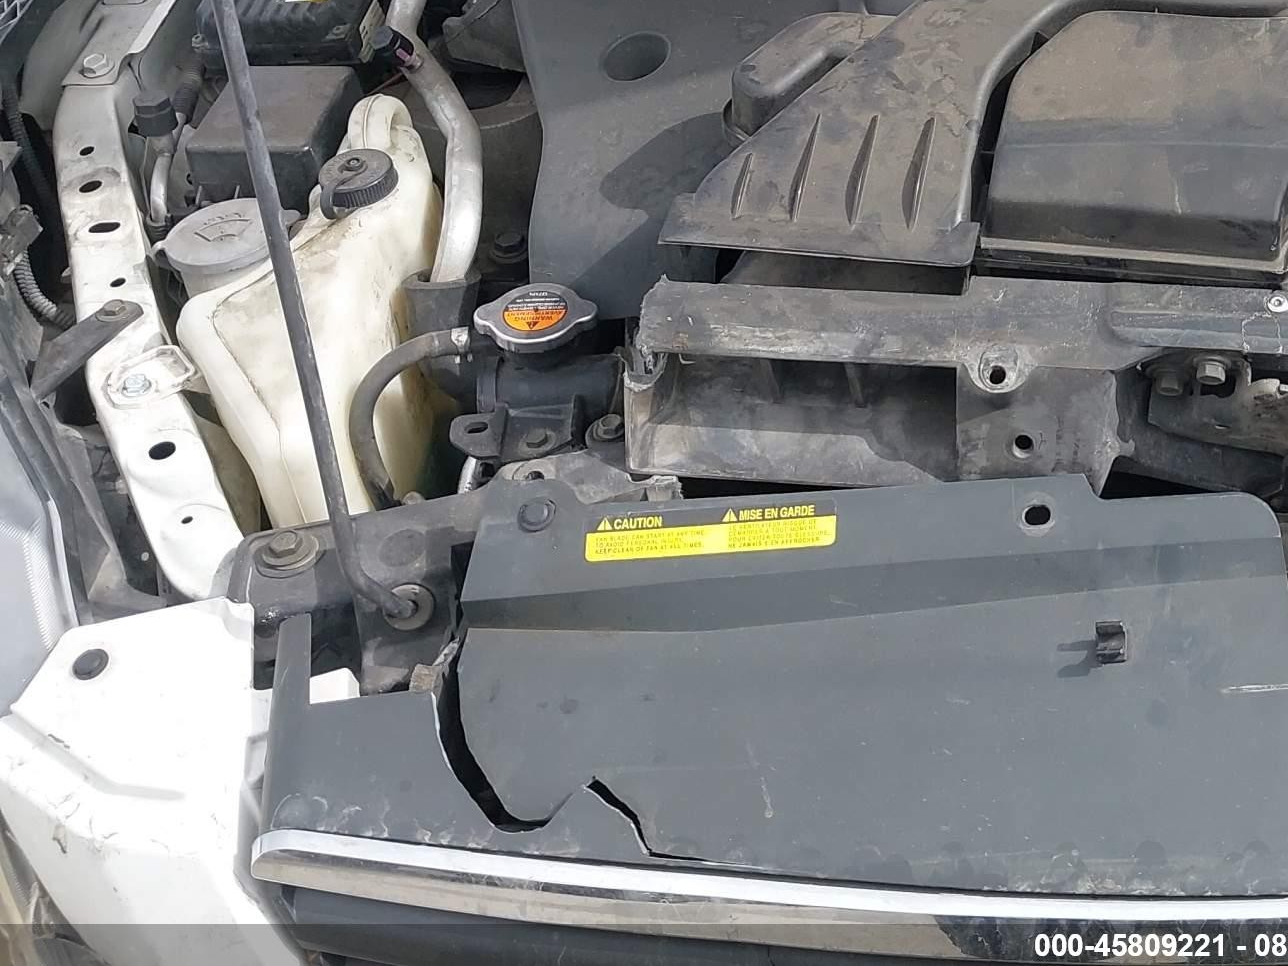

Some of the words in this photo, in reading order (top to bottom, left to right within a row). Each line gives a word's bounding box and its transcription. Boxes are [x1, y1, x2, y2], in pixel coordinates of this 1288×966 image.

[739, 509, 763, 521] MISE
[764, 508, 779, 519] EN
[780, 505, 815, 517] GARDE
[613, 516, 663, 530] CAUTION
